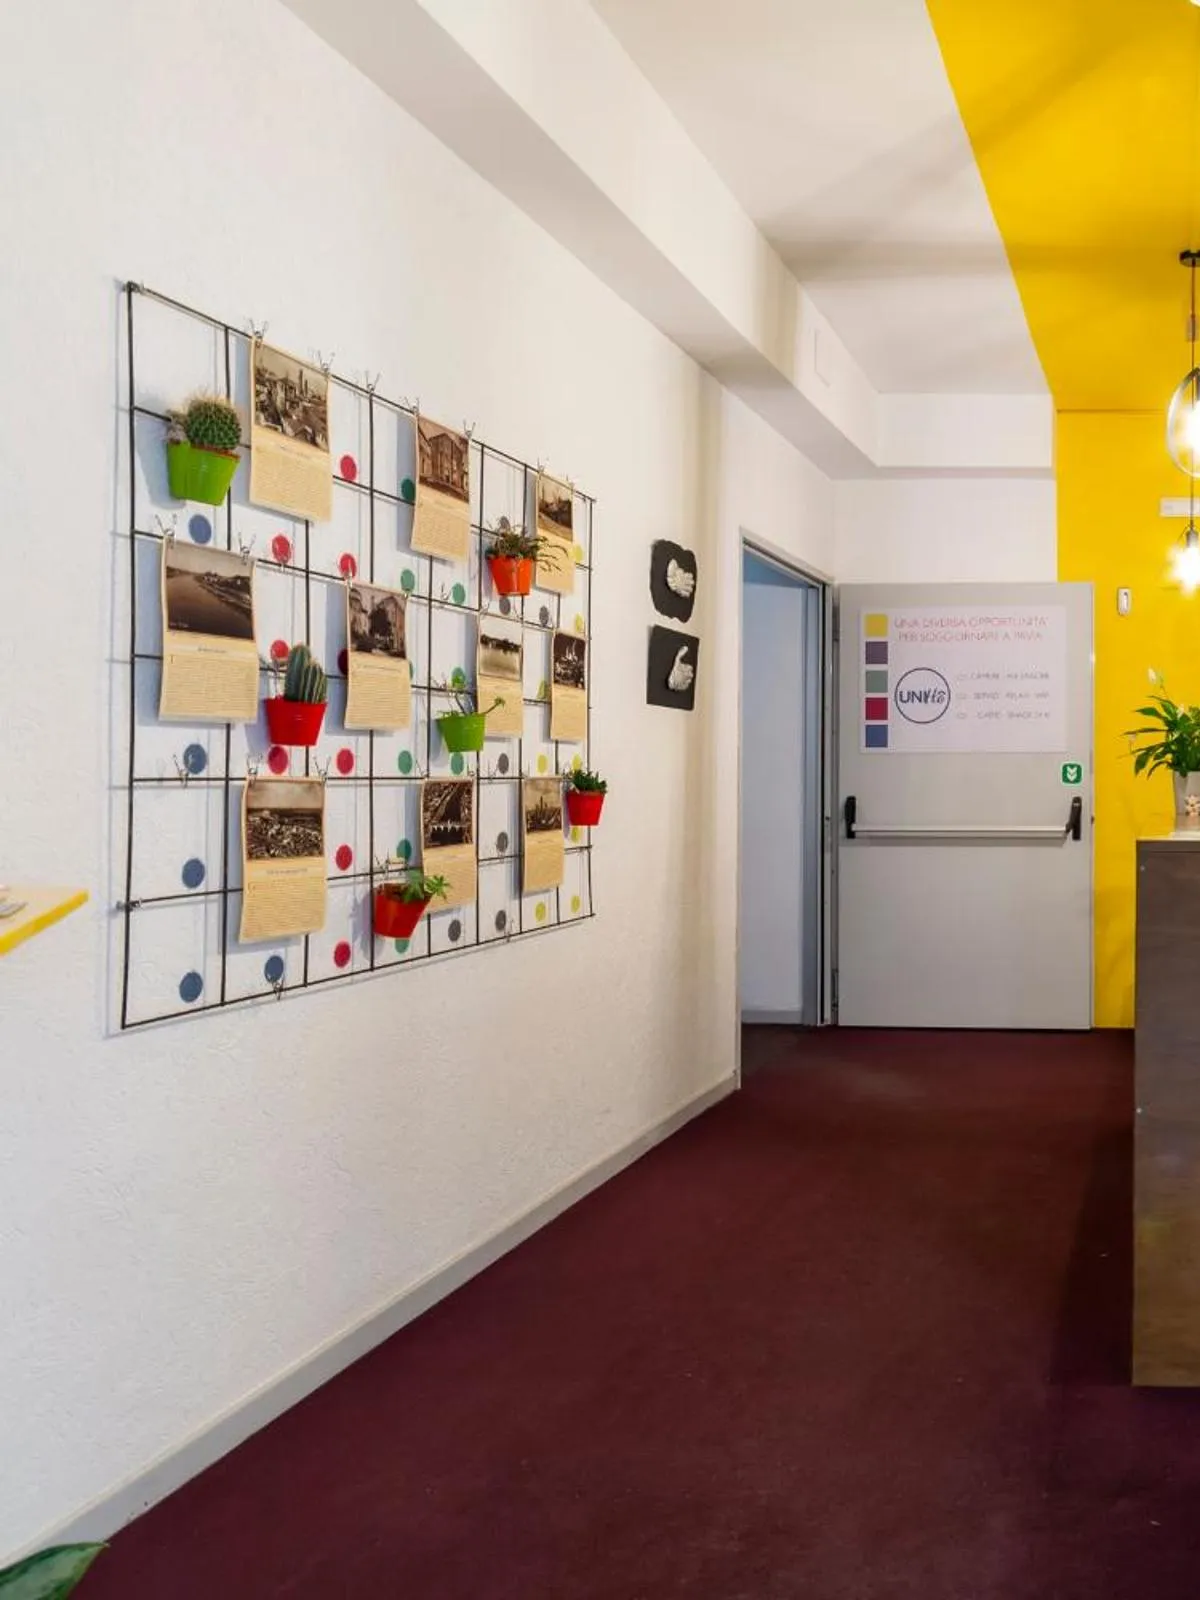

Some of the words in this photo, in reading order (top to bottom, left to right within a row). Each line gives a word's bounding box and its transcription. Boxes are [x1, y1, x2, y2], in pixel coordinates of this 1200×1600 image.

[893, 616, 919, 629] UNA
[898, 631, 918, 643] PER
[1003, 630, 1012, 642] A
